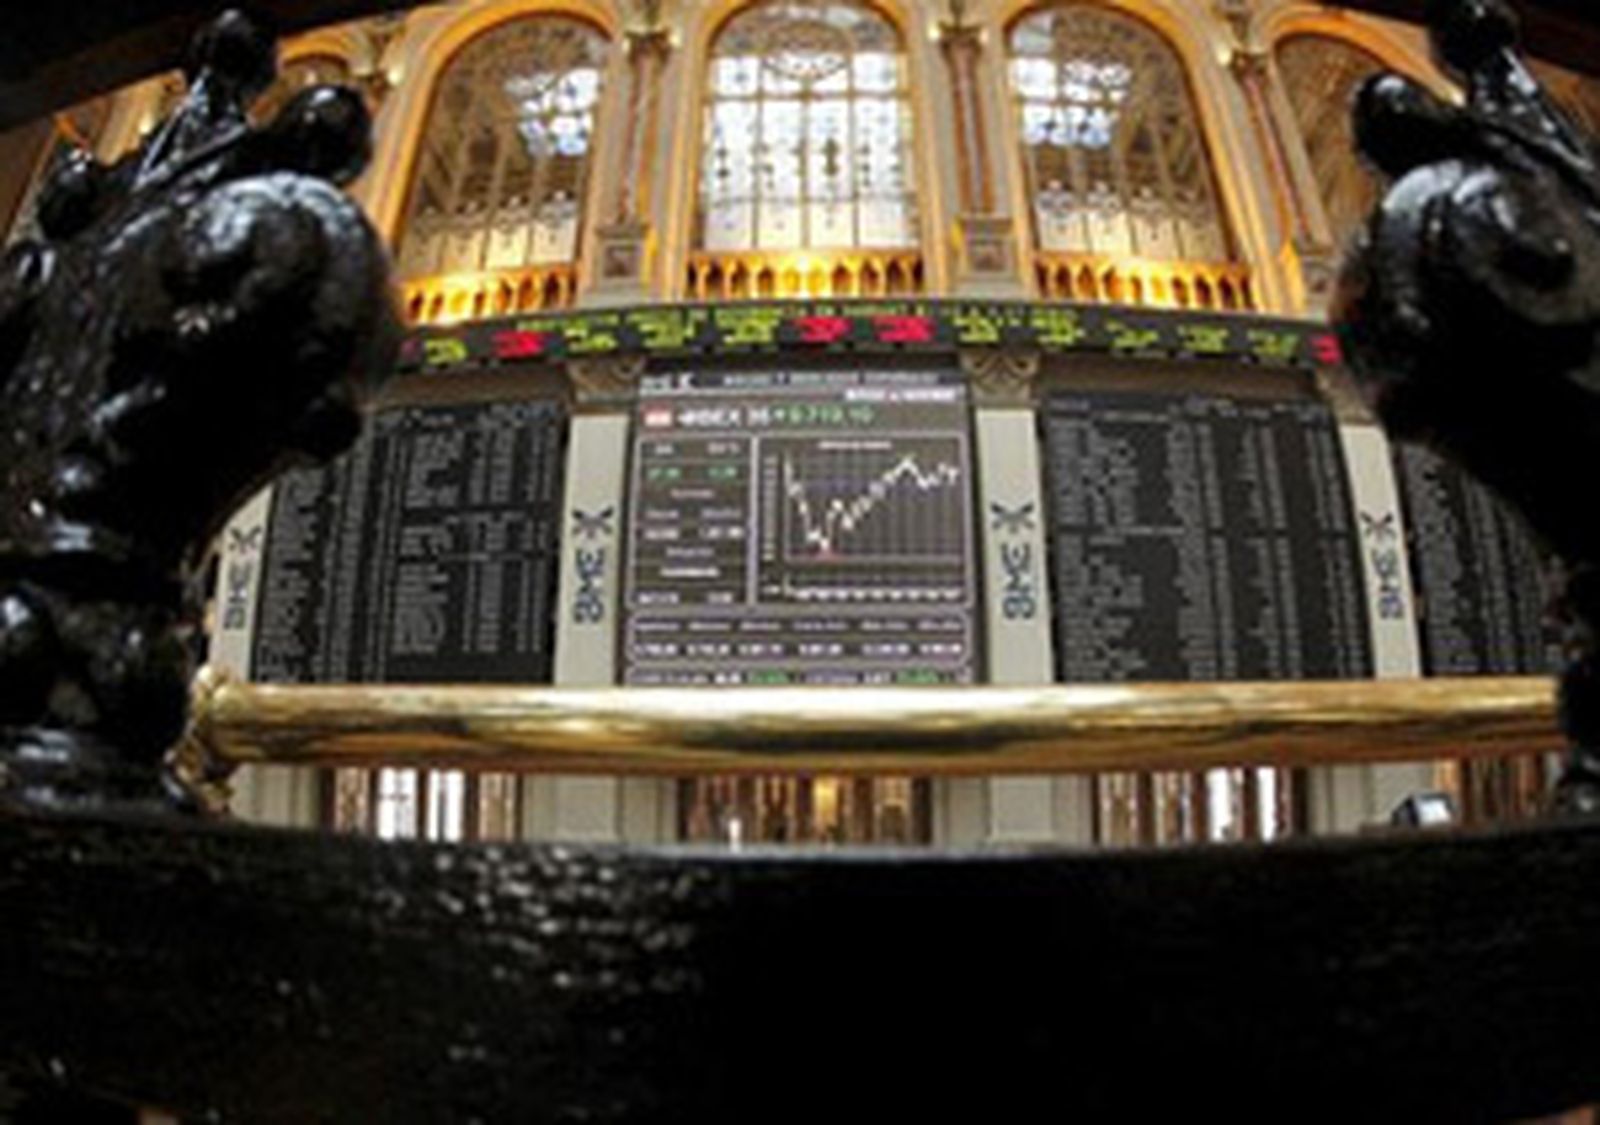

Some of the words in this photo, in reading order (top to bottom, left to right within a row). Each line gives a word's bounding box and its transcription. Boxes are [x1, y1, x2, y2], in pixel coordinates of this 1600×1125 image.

[227, 562, 254, 631] BME
[574, 547, 605, 624] BME
[1000, 541, 1036, 620] BME
[1369, 548, 1404, 620] BME
